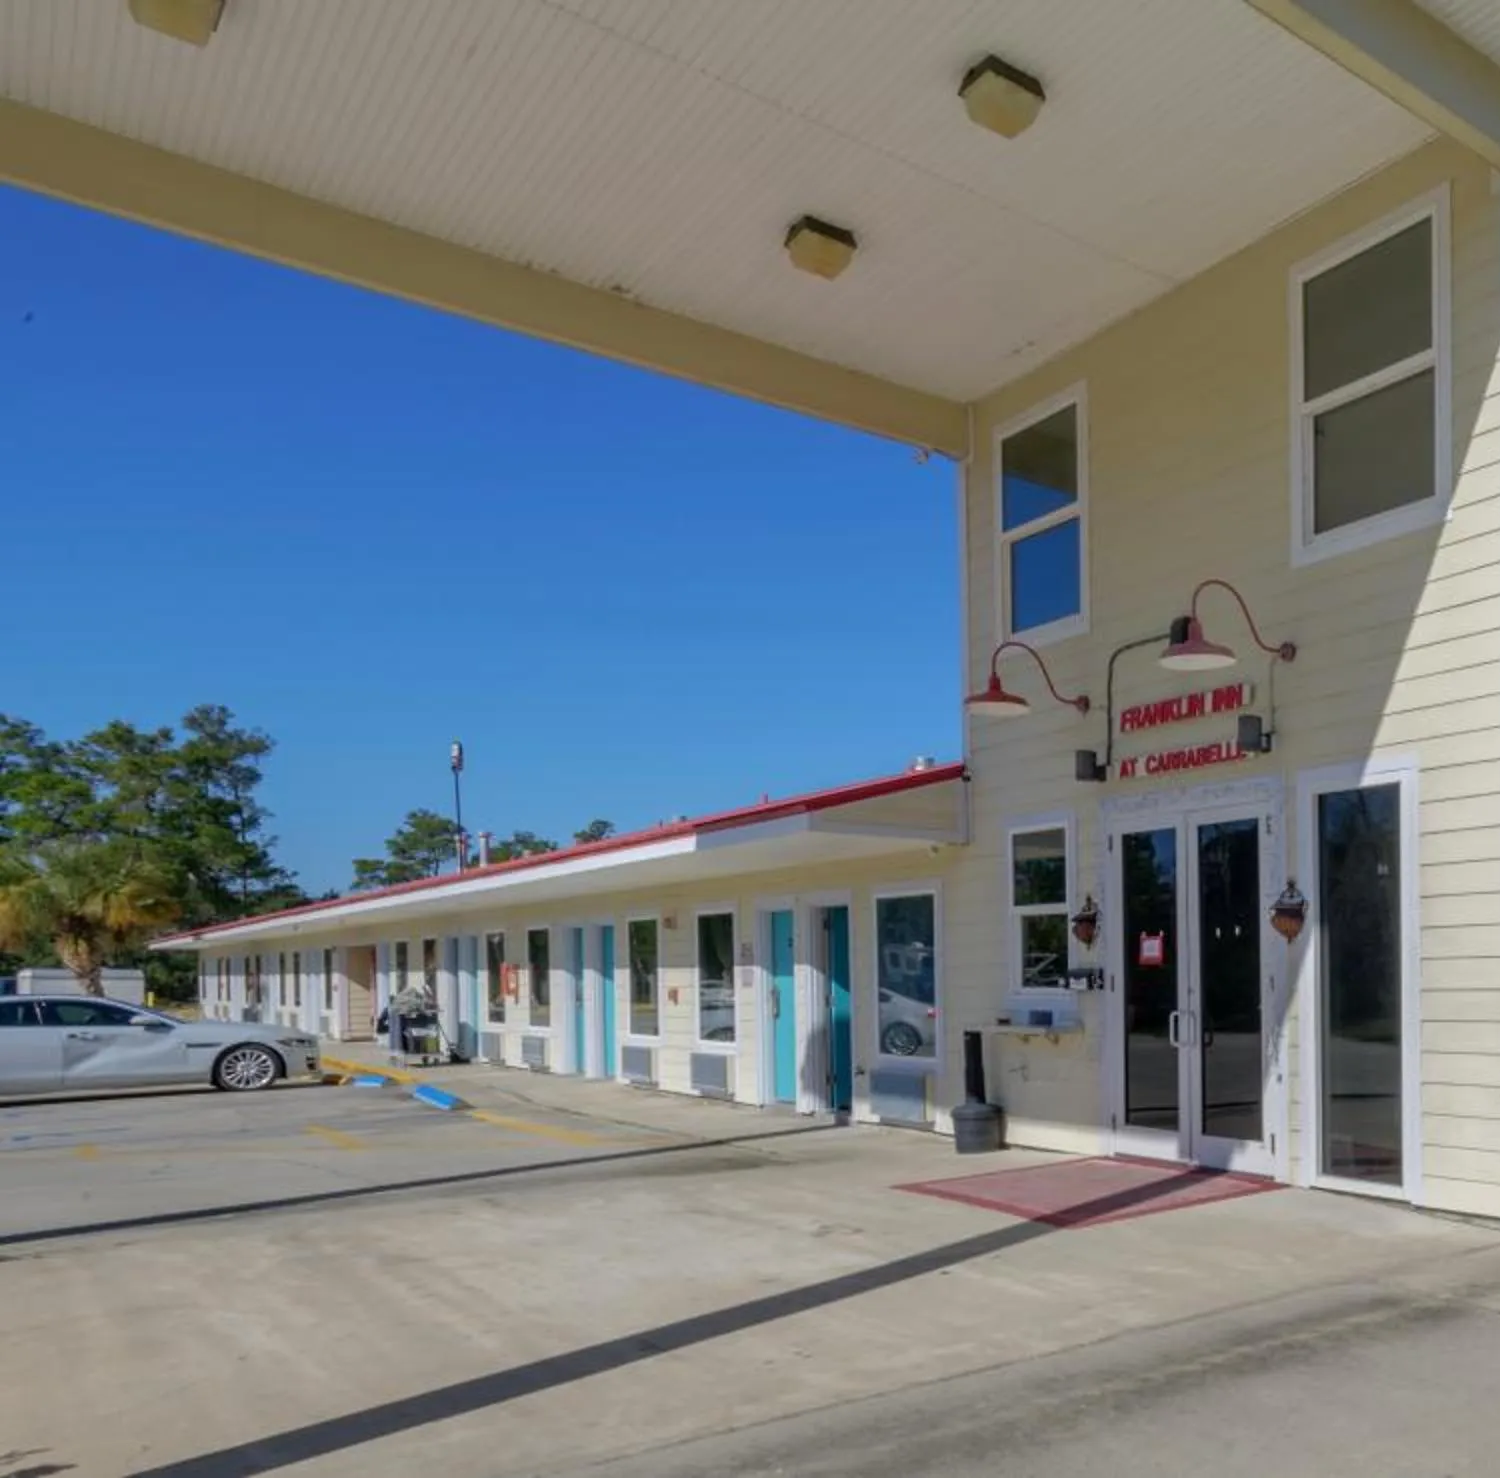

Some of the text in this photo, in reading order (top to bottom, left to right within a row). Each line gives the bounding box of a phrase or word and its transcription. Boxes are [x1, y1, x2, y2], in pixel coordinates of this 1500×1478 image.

[1120, 682, 1243, 732] FRANKLIN INN
[1120, 757, 1138, 777] AT
